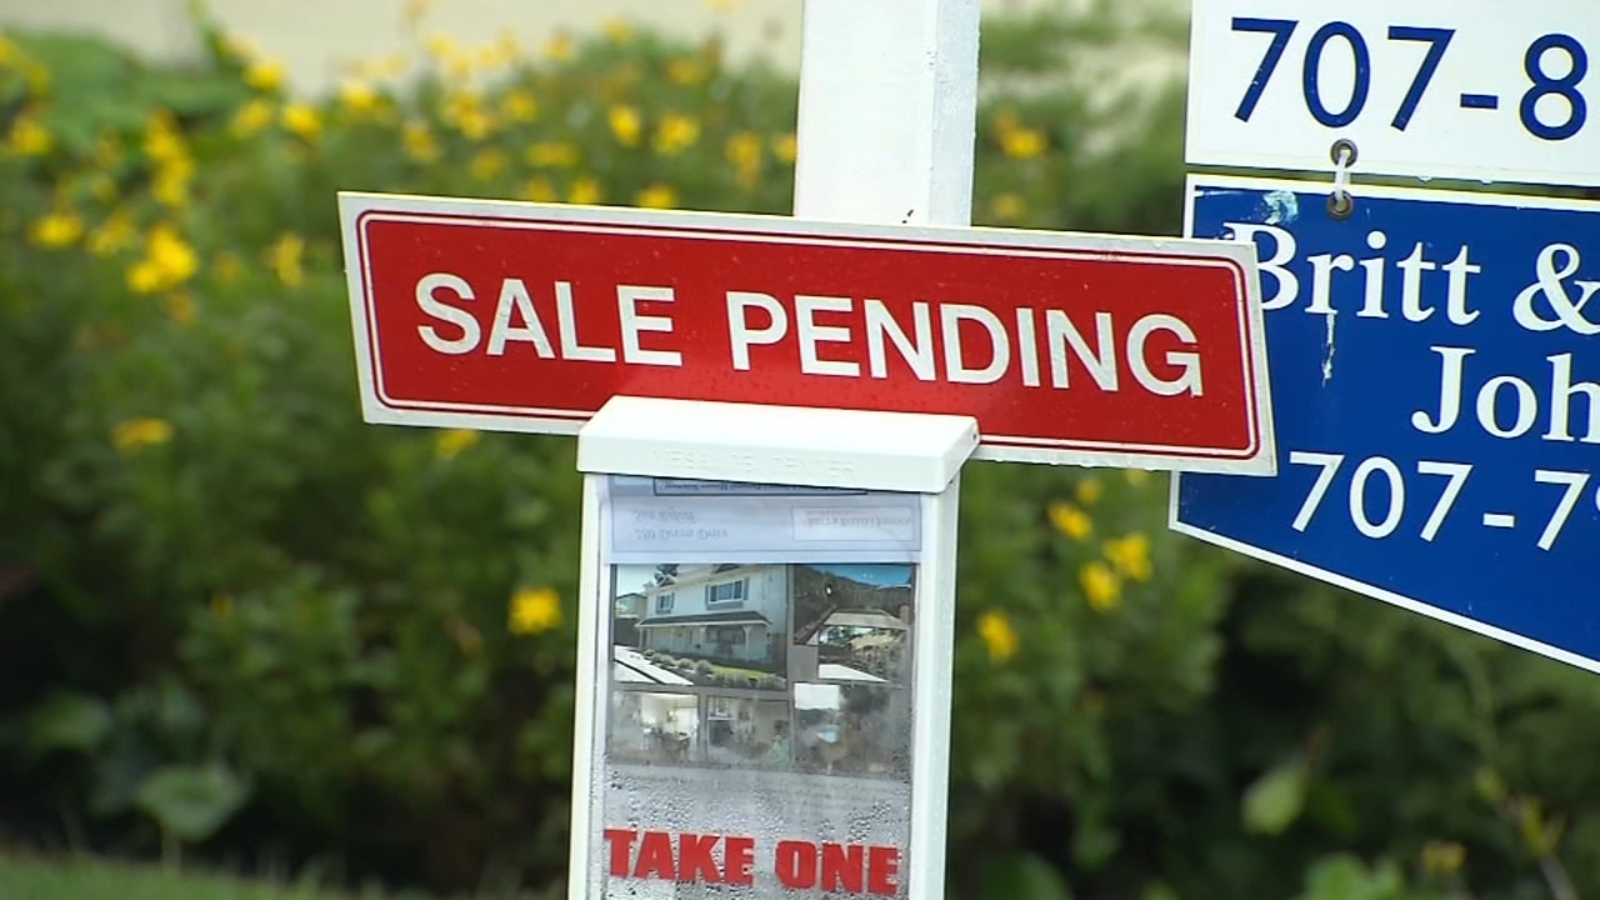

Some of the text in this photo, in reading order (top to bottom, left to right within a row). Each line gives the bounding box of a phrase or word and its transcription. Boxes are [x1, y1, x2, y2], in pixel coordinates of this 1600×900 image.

[1231, 16, 1588, 141] 707-8
[1223, 221, 1600, 335] Britt &
[415, 272, 1205, 398] SALE PENDING
[1411, 345, 1600, 443] Joh
[1289, 450, 1600, 551] 707-7
[603, 828, 898, 896] TAKE ONE
